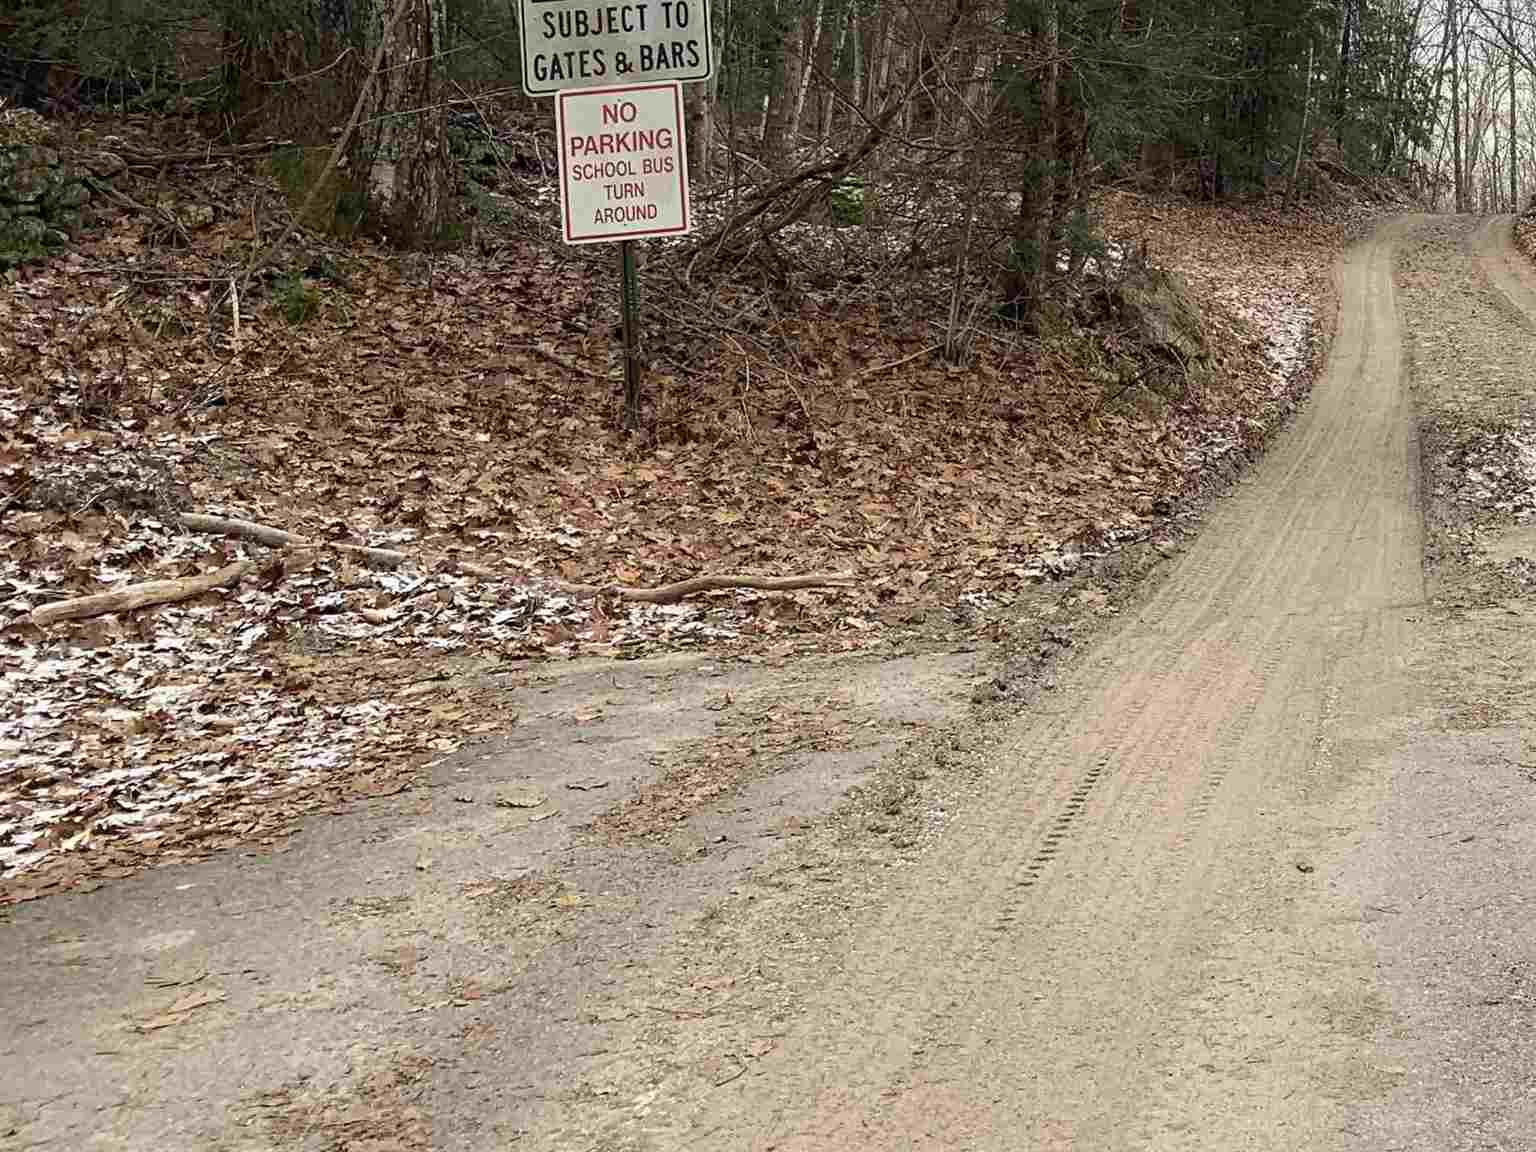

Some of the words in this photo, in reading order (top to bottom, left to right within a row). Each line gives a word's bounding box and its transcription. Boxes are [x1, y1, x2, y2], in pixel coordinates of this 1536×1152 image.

[543, 4, 647, 39] SUBJECT
[661, 1, 688, 28] TO
[534, 49, 606, 81] GATES
[615, 52, 633, 73] &
[640, 40, 700, 72] BARS
[602, 102, 637, 124] NO
[571, 128, 672, 156] PARKING
[572, 160, 636, 181] SCHOOL
[643, 157, 674, 174] BUS
[604, 182, 645, 200] TURN
[594, 204, 657, 224] AROUND
